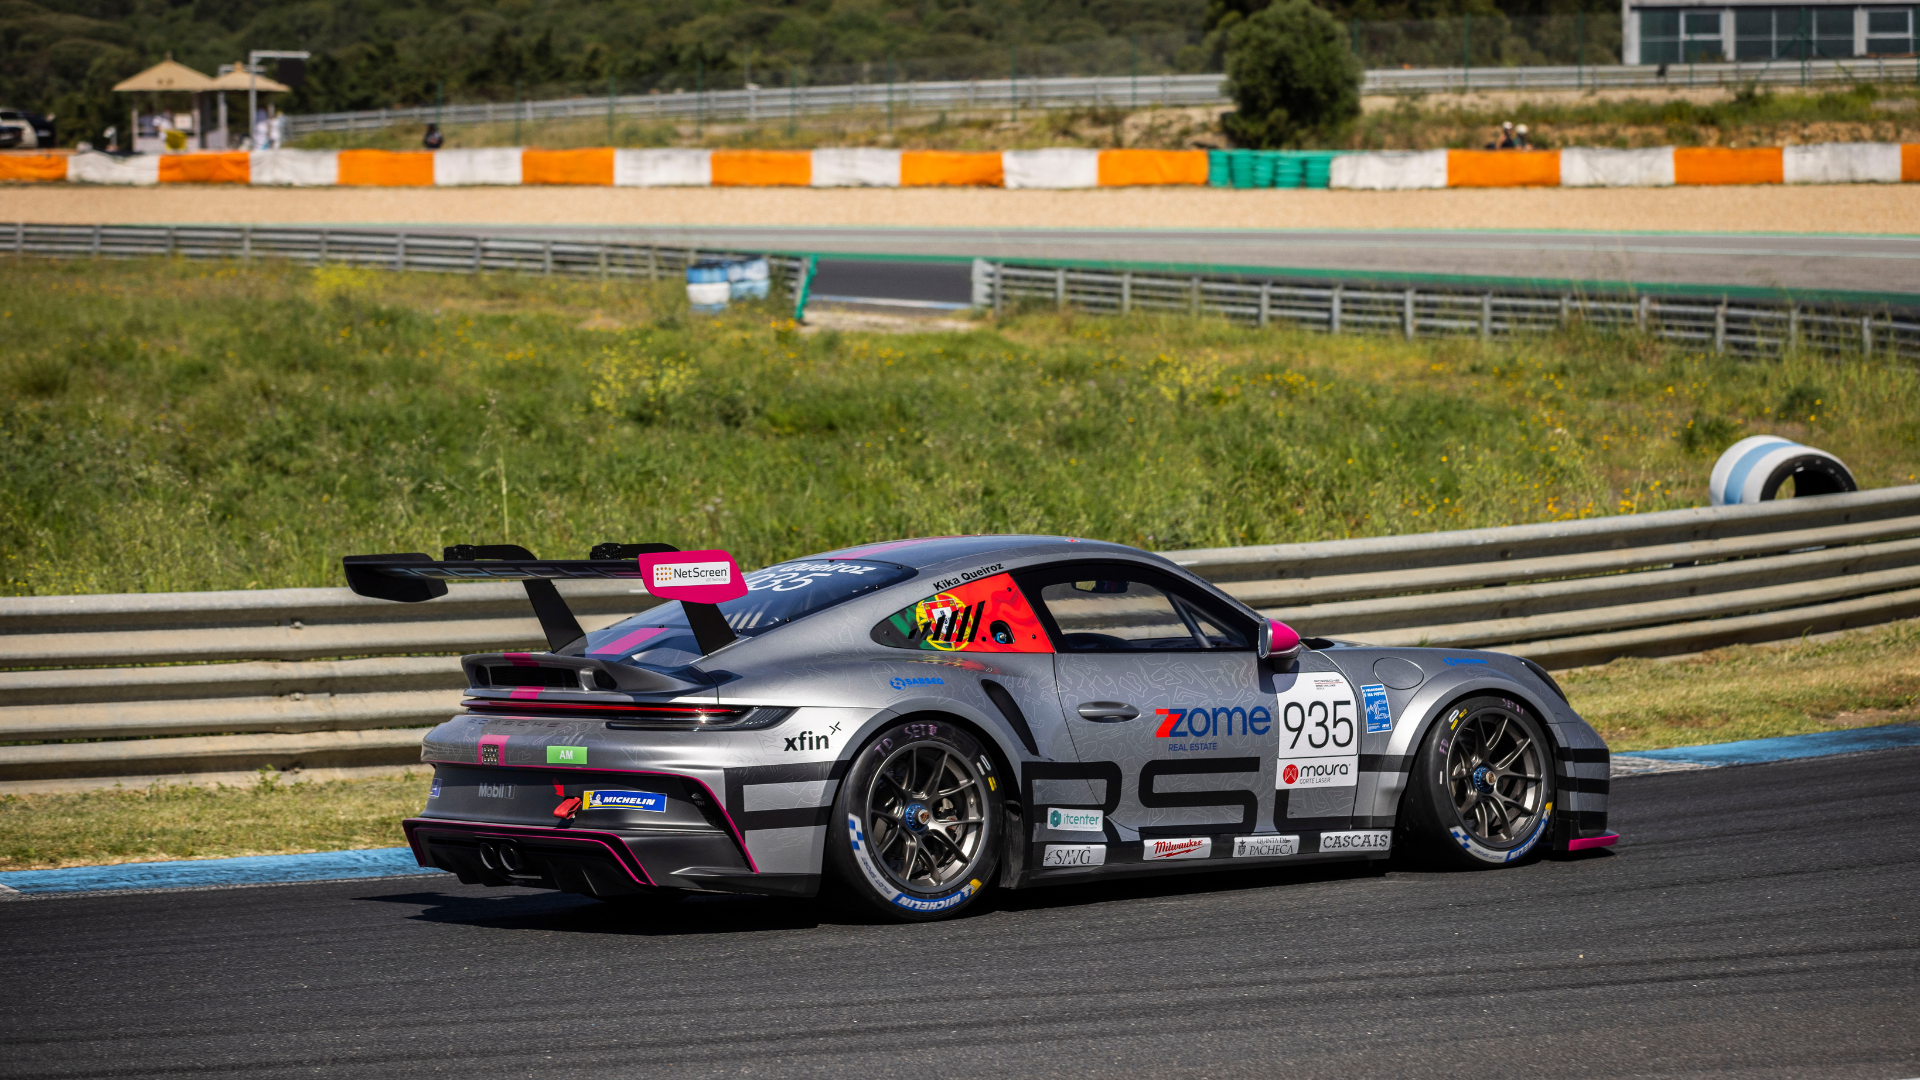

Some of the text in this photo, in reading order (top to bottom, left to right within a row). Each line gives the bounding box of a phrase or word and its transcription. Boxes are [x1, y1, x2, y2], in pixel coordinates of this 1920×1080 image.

[673, 567, 727, 579] NetScreen
[933, 563, 1004, 591] Kika Queiroz
[1155, 706, 1272, 738] zome
[1283, 700, 1354, 750] 935
[783, 730, 830, 752] xfin
[1168, 742, 1218, 752] REAL ESTATE
[559, 749, 574, 760] AM
[1300, 763, 1349, 777] moura
[478, 783, 504, 798] Mobil
[603, 796, 656, 806] MICHELIN
[1063, 813, 1100, 826] itcenter
[1153, 839, 1203, 854] Milwaukee
[1323, 834, 1388, 849] CASCAIS
[1249, 844, 1294, 856] PACHECA
[861, 856, 892, 895] PILOT SPORT
[897, 893, 961, 911] MICHELIN
